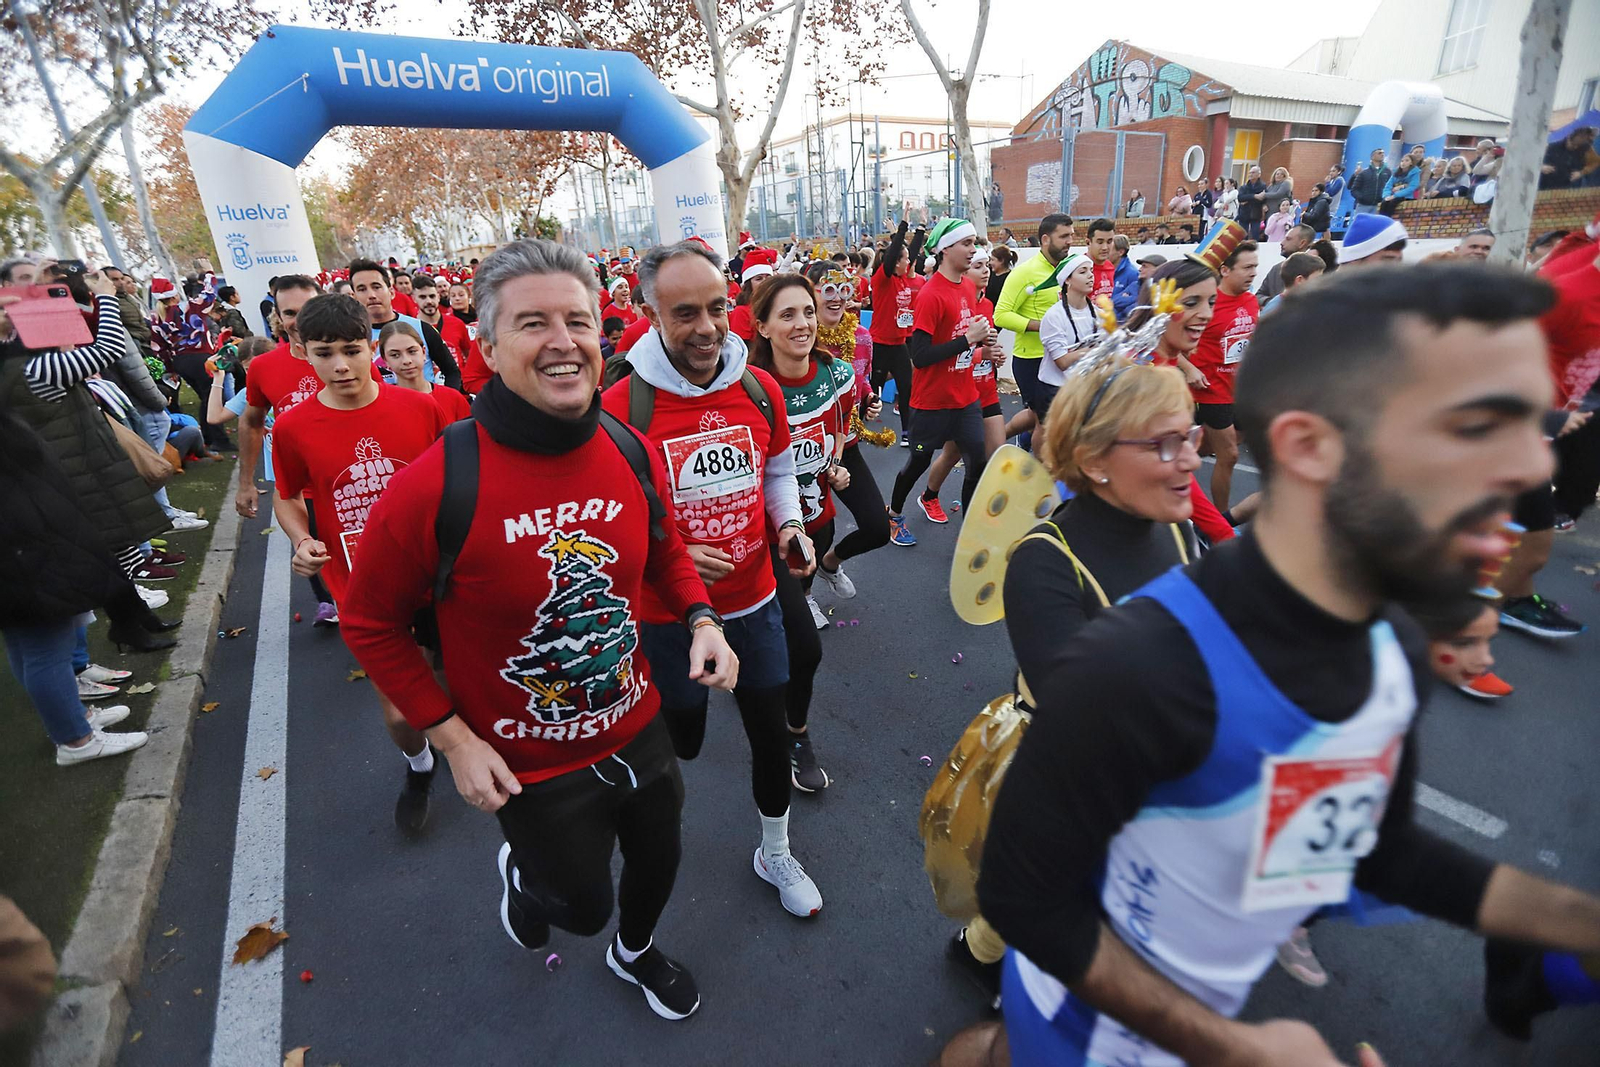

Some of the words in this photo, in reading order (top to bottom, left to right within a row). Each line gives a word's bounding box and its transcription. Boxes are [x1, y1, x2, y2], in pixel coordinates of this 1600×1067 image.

[332, 47, 481, 92] Huelva
[493, 59, 611, 104] original
[216, 203, 289, 221] Huelva
[676, 192, 719, 208] Huelva
[256, 255, 299, 265] HUELVA
[693, 446, 735, 477] 488
[793, 441, 812, 462] 70
[349, 458, 395, 480] XIII
[503, 498, 623, 543] MERRY
[688, 511, 749, 538] 2023
[493, 672, 648, 741] CHRISTMAS
